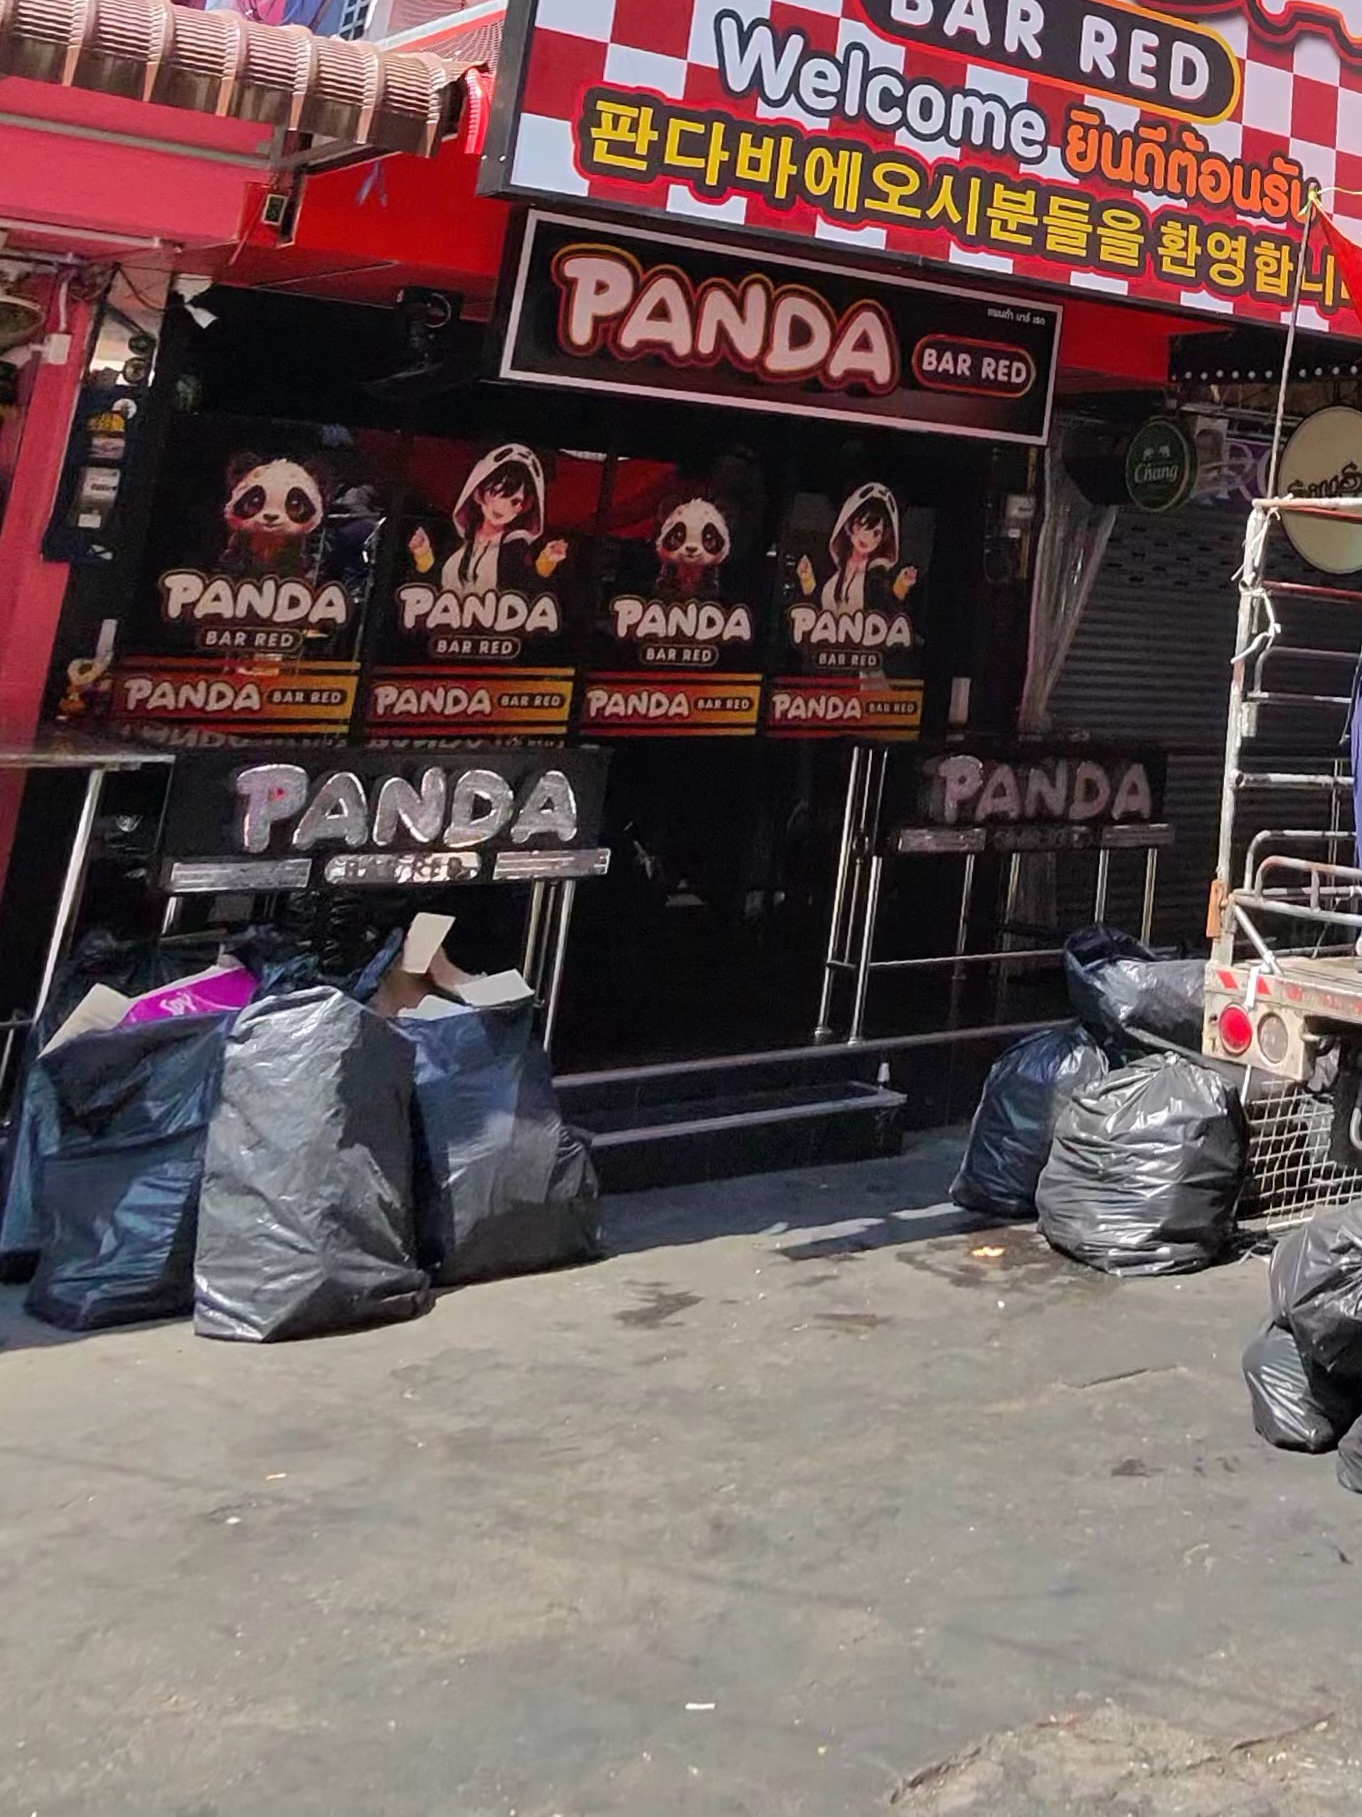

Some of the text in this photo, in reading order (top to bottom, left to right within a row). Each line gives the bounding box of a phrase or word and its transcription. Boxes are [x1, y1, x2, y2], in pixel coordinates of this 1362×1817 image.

[1078, 27, 1211, 102] RED
[719, 15, 1048, 160] Welcome
[590, 99, 1350, 307] 판다바에오시분들을 환영합니
[561, 255, 895, 386] PANDA
[921, 348, 1028, 385] BAR RED
[1134, 463, 1179, 483] Chang
[163, 573, 347, 624] PANDA
[399, 586, 559, 632] PANDA
[205, 630, 295, 648] BAR RED
[613, 598, 751, 641] PANDA
[790, 607, 911, 648] PANDA
[436, 639, 513, 655] BAR RED
[682, 649, 712, 662] RED
[124, 678, 261, 712] PANDA
[373, 685, 492, 716] PANDA
[586, 689, 690, 718] PANDA
[771, 693, 862, 721] PANDA
[236, 763, 577, 853] PANDA
[938, 754, 1152, 823] PANDA
